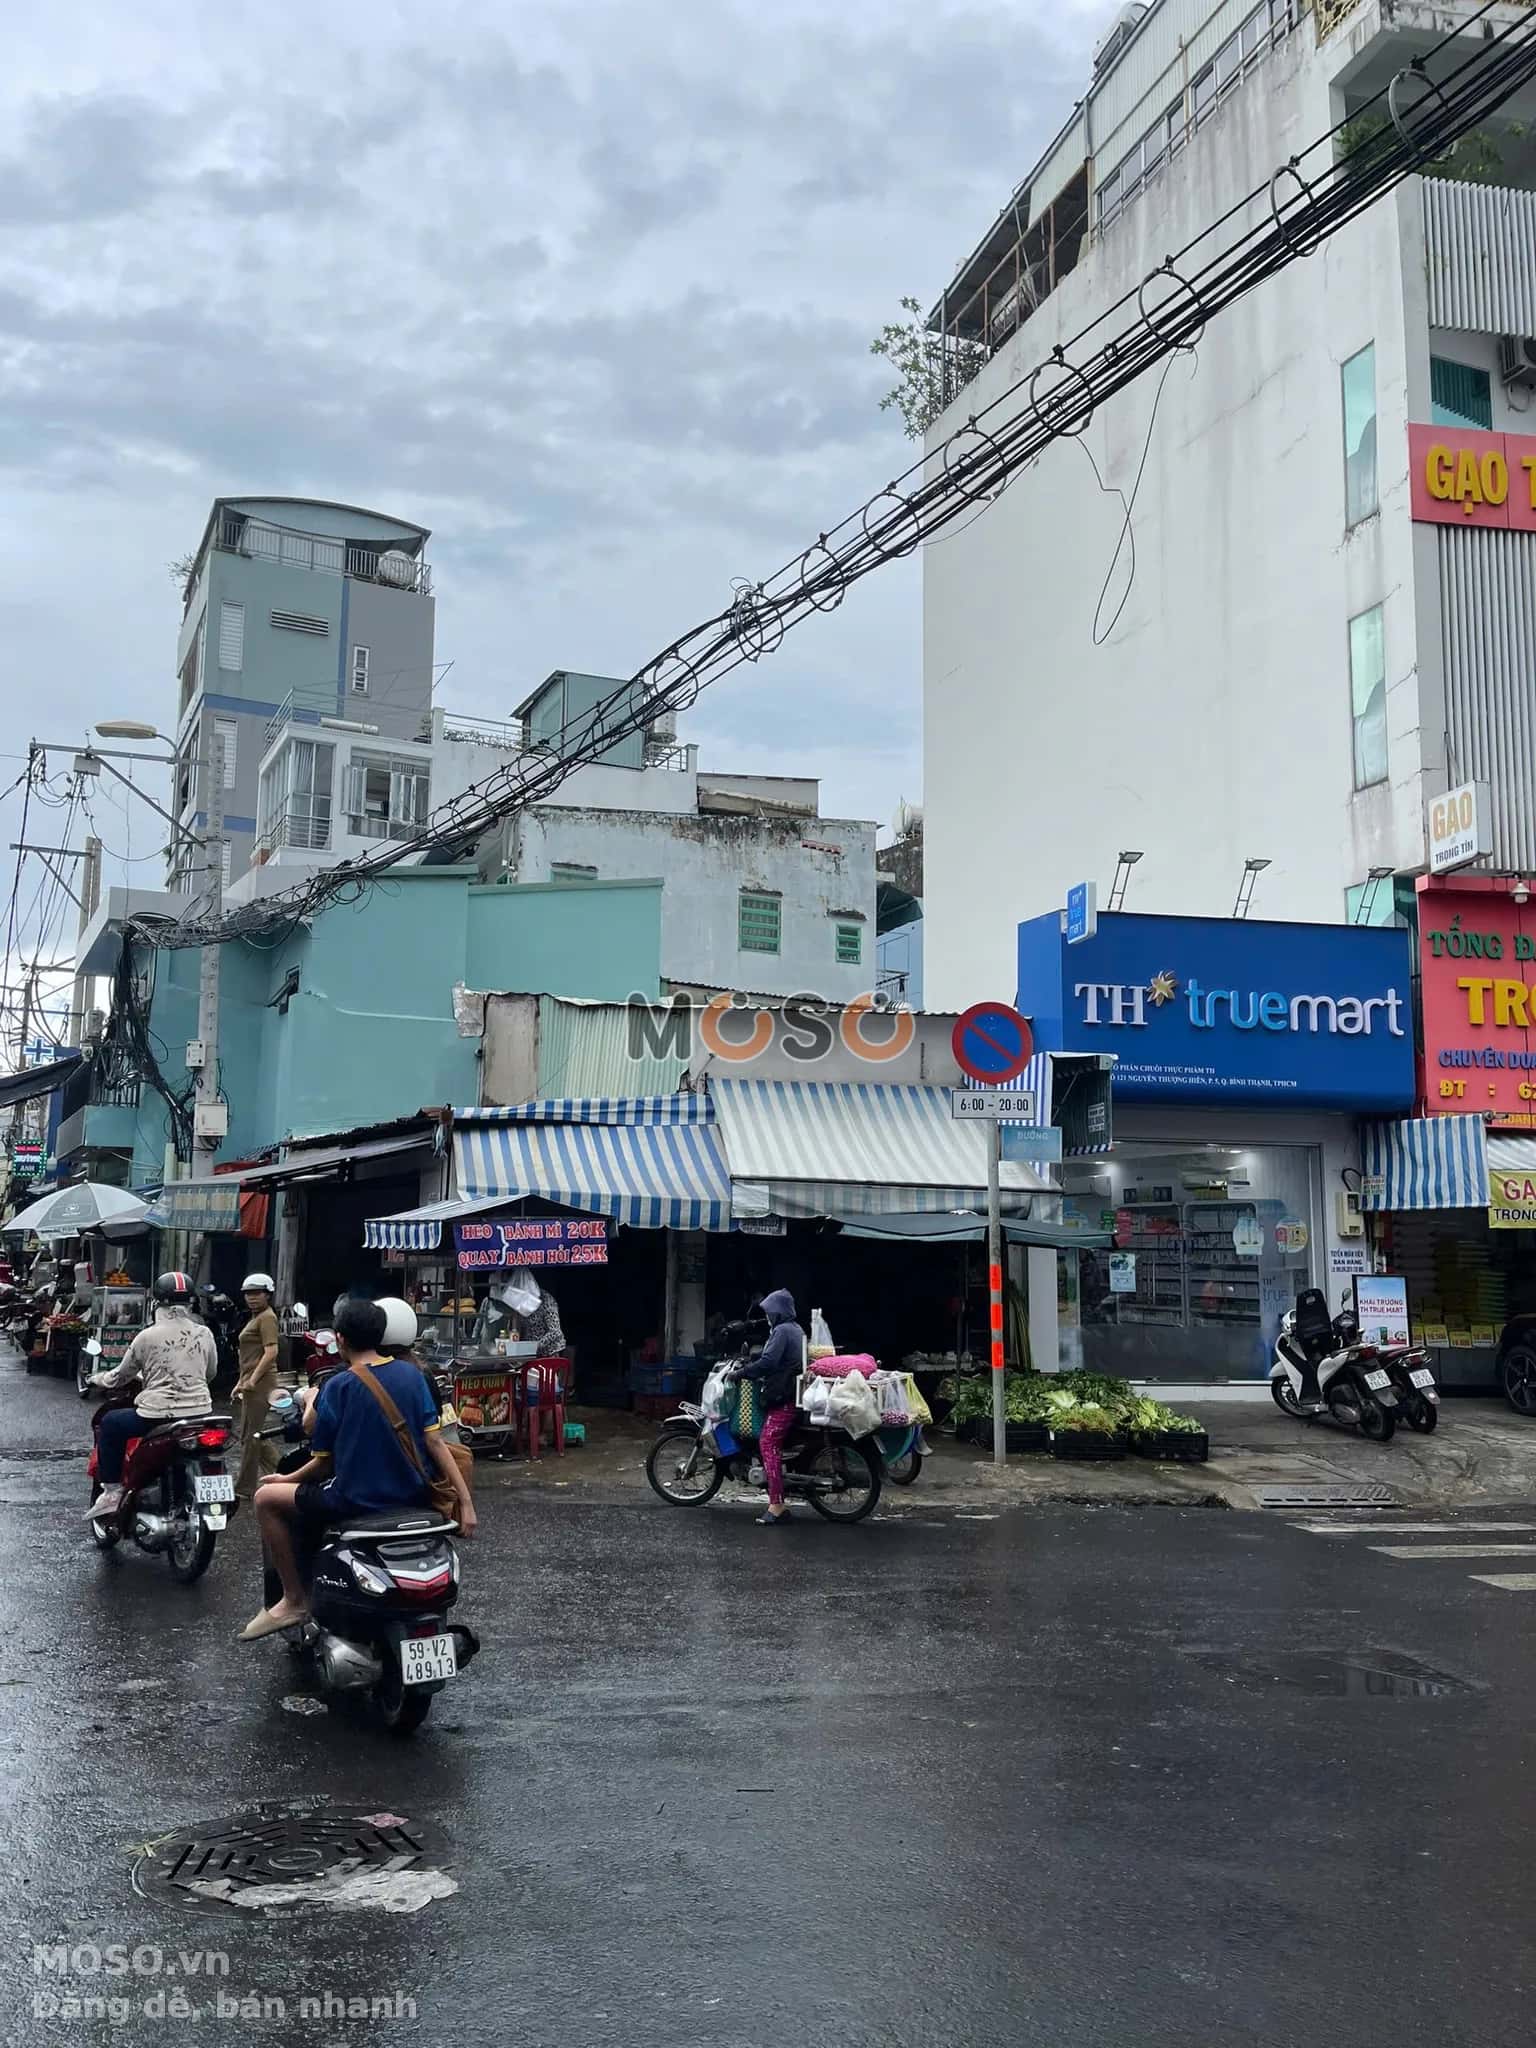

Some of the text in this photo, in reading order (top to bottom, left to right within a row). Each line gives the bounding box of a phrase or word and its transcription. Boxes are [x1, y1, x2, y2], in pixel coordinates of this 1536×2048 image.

[1426, 444, 1508, 514] GẠO
[1427, 914, 1503, 960] TỔNG
[1074, 983, 1148, 1026] TH
[1457, 977, 1536, 1027] TR
[1439, 1047, 1505, 1069] CHUYÊN
[1439, 1079, 1467, 1098] ĐT
[960, 1098, 984, 1111] 6:00
[999, 1098, 1029, 1111] 20:00
[461, 1223, 493, 1240] HEO
[504, 1222, 543, 1240] BÁNH
[567, 1221, 606, 1239] 20K
[458, 1249, 500, 1269] QUAY
[506, 1248, 545, 1265] BÁNH
[571, 1244, 608, 1264] 25K
